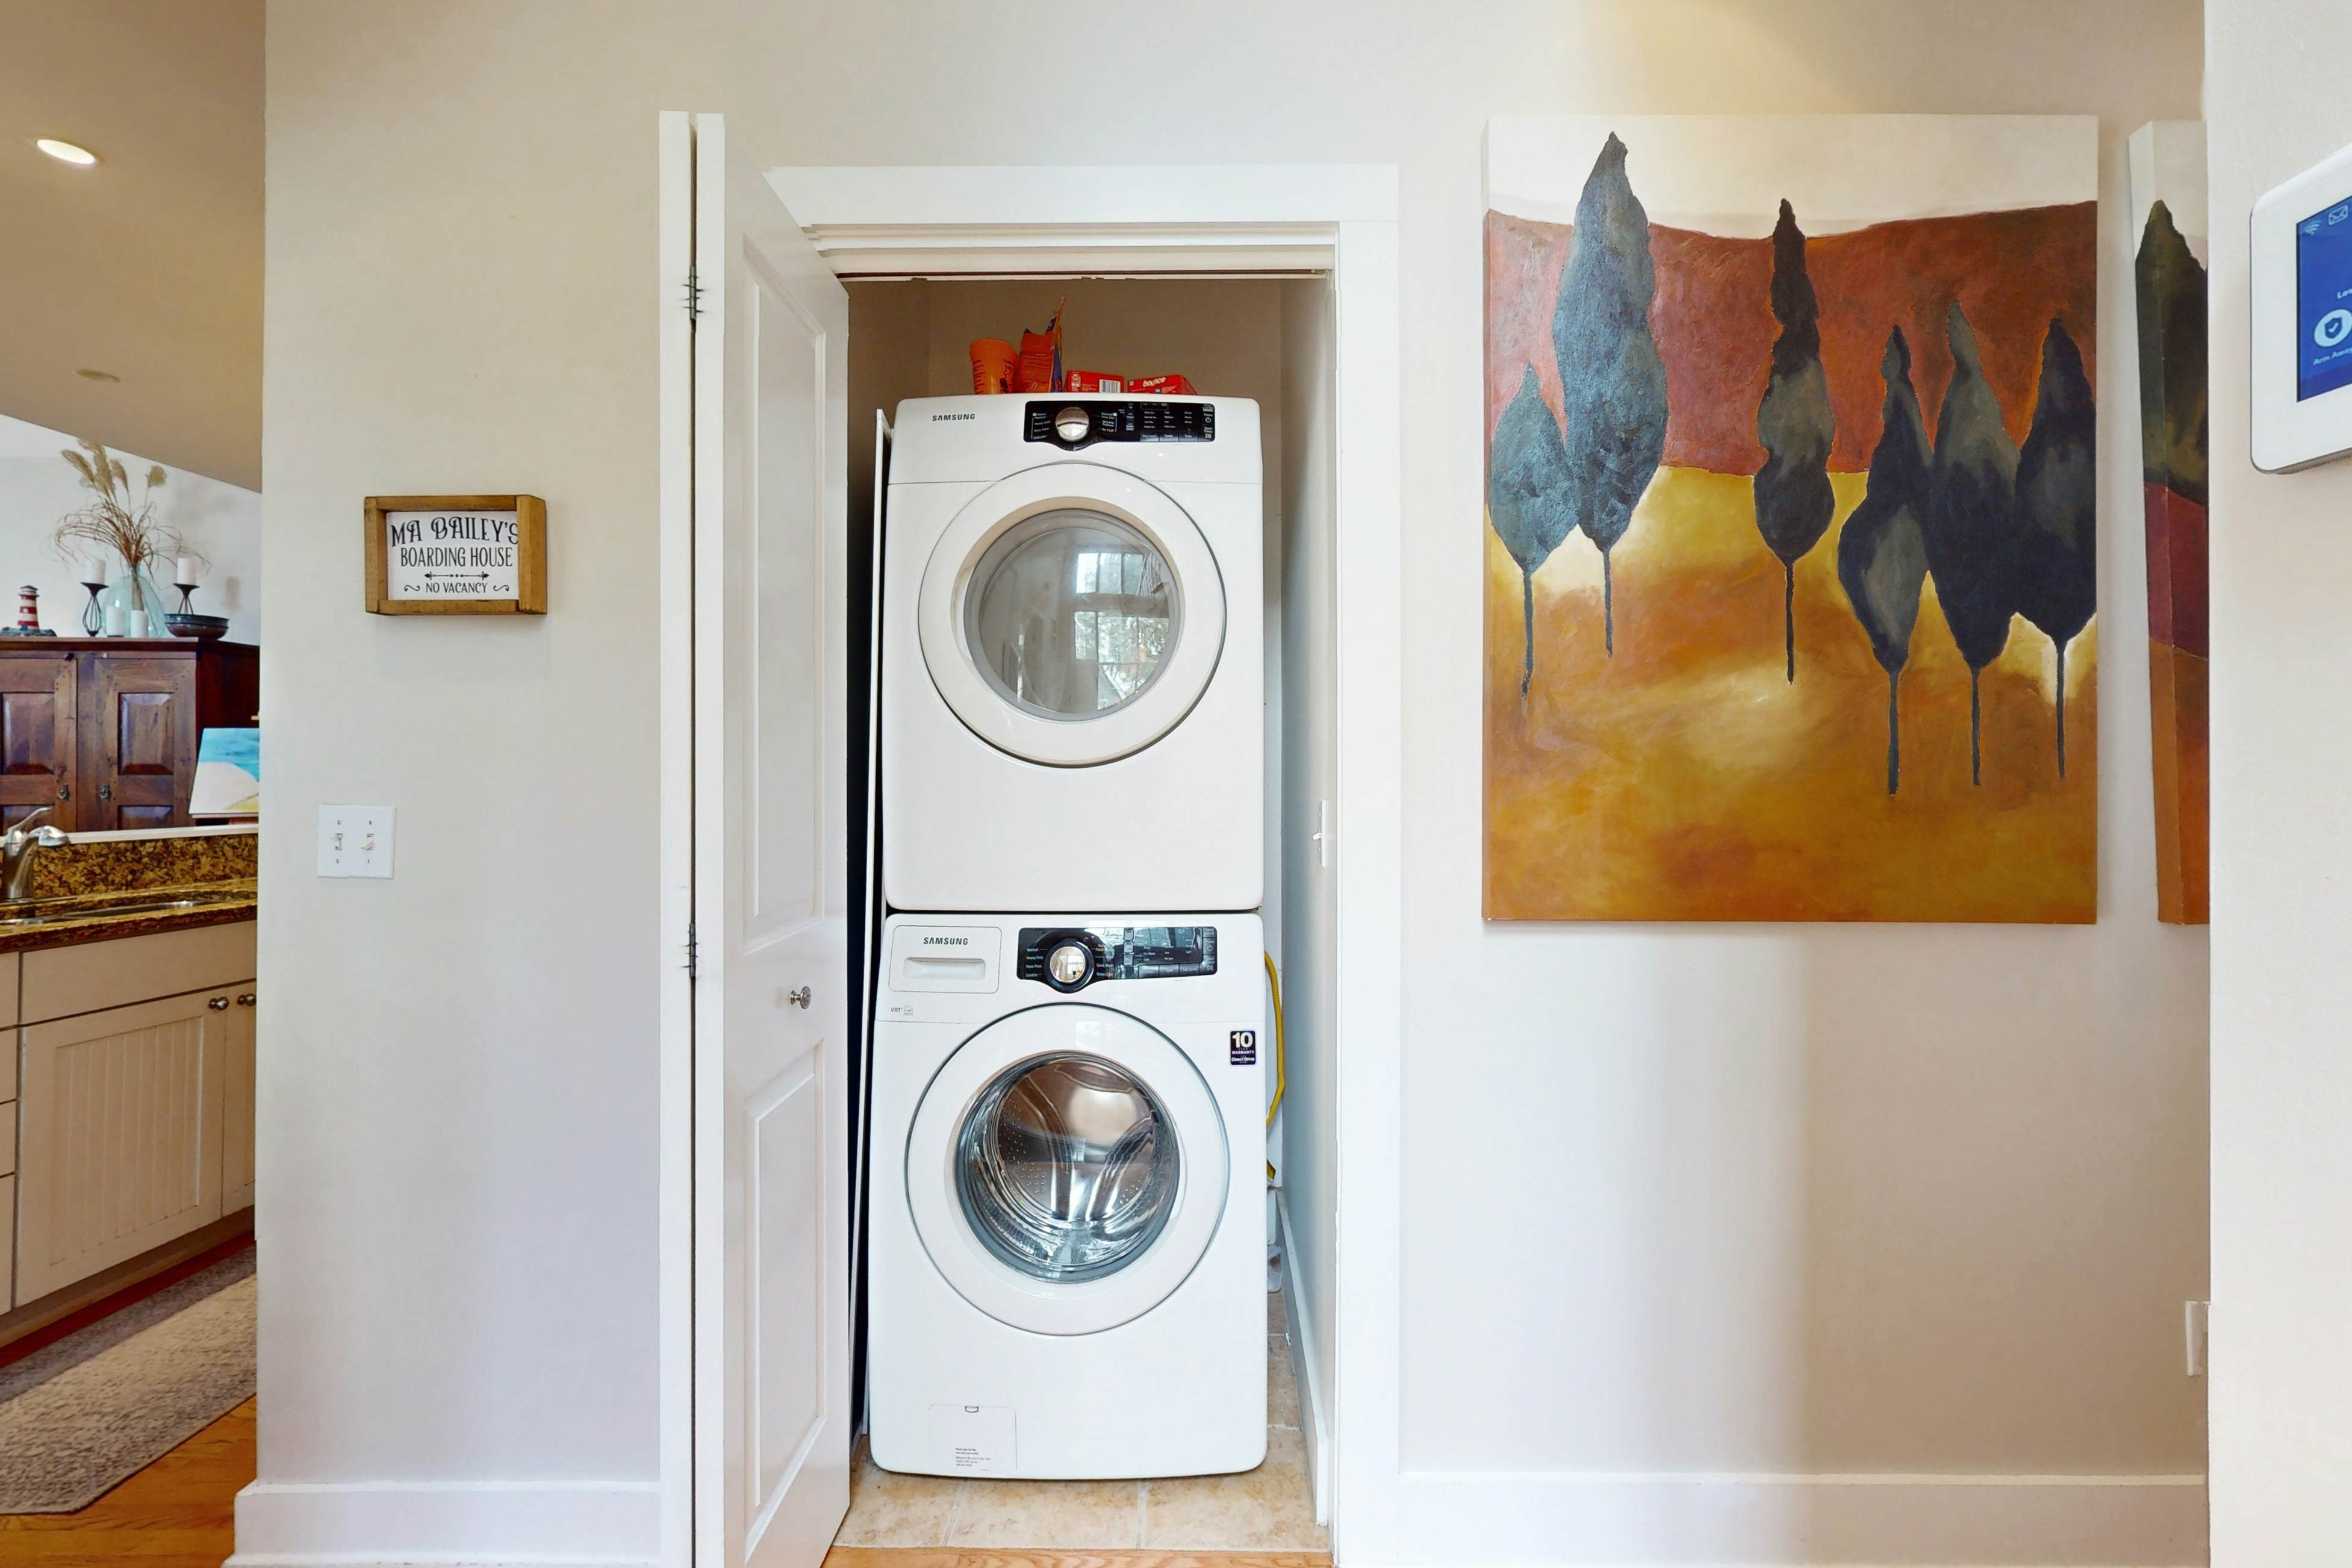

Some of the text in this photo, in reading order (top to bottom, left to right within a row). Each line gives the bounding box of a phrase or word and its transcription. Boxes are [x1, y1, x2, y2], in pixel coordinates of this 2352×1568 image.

[1143, 377, 1166, 387] bounce
[391, 517, 518, 547] MA BAILEY'S
[401, 547, 513, 567] BOARDING HOUSE
[426, 582, 488, 593] NO VACANCY
[923, 937, 968, 945] SAMSUNG
[1232, 1031, 1253, 1048] 10
